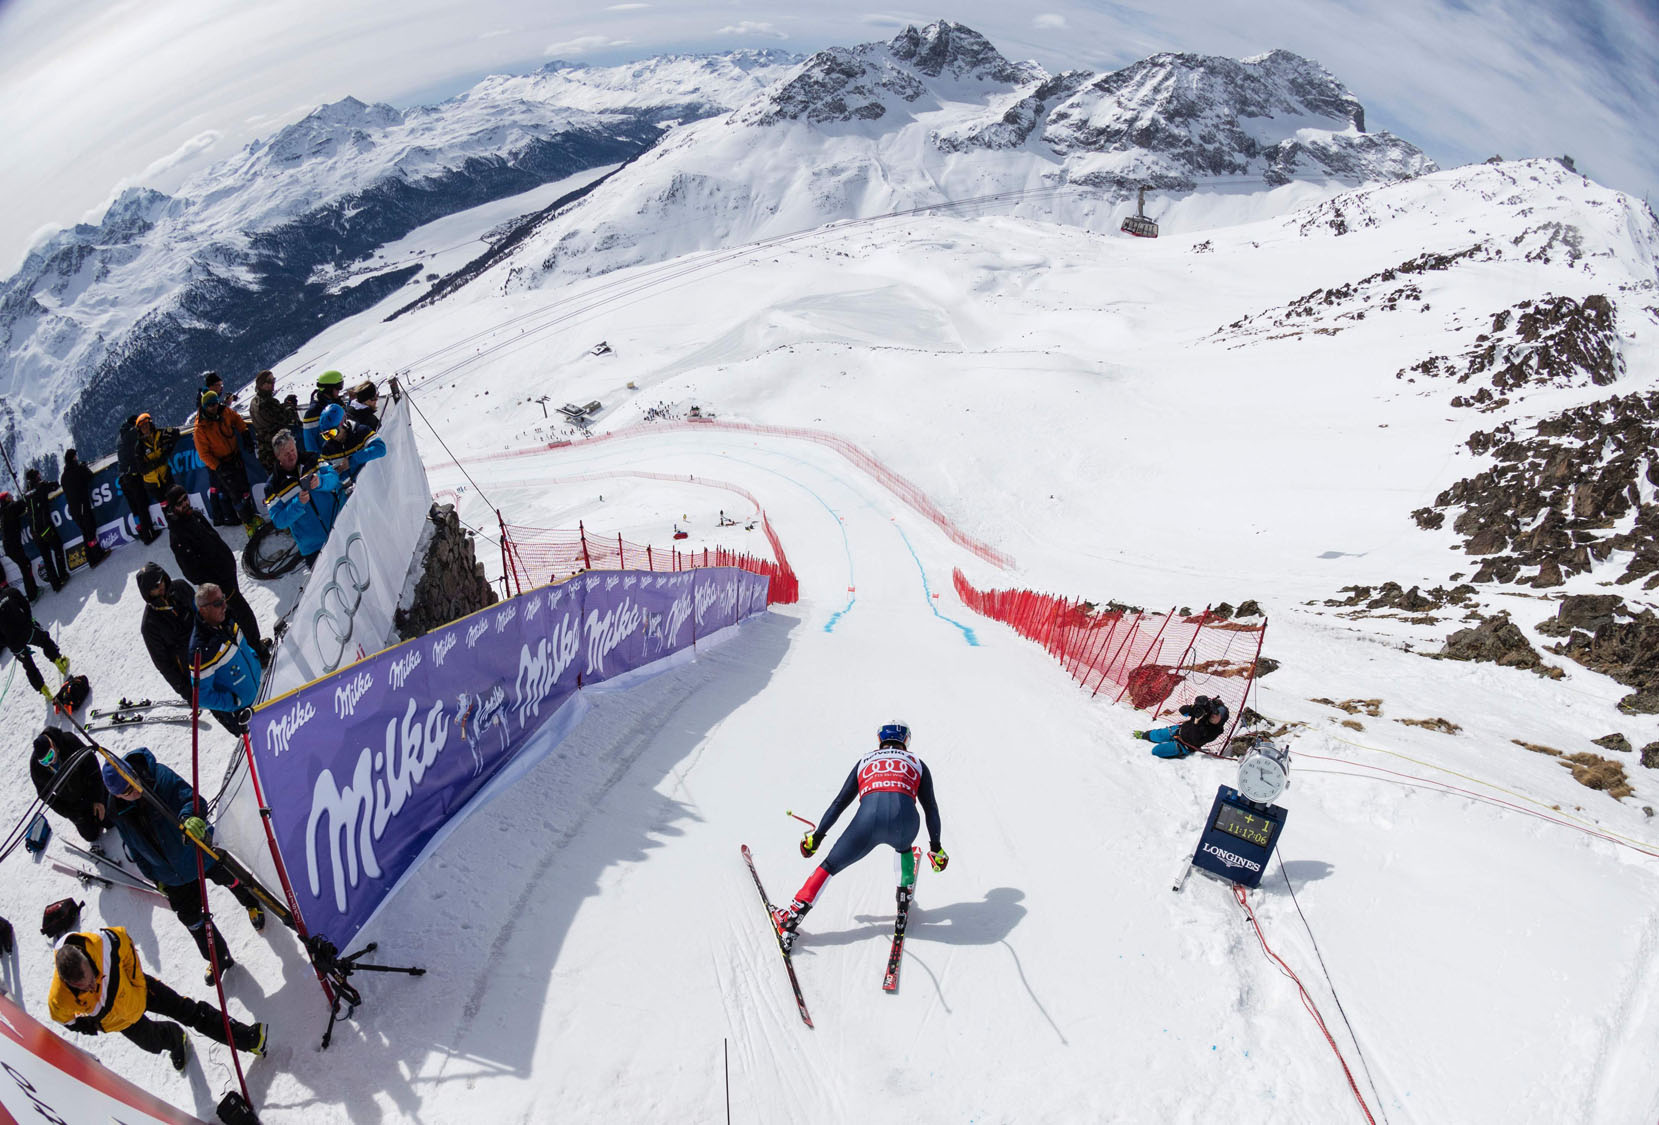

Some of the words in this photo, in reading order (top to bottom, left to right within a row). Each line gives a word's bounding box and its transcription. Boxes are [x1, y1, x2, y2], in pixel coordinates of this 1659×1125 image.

[465, 617, 489, 649] Milka
[495, 604, 516, 634] Milka
[583, 596, 641, 676] Milka
[388, 649, 422, 691] Milka
[432, 632, 457, 668] Milka
[511, 612, 580, 729] Milka
[334, 672, 374, 720] Milka
[266, 701, 316, 757] Milka
[306, 698, 450, 914] Milka
[1227, 823, 1268, 845] 11:17:06
[1203, 843, 1261, 872] LONGINES
